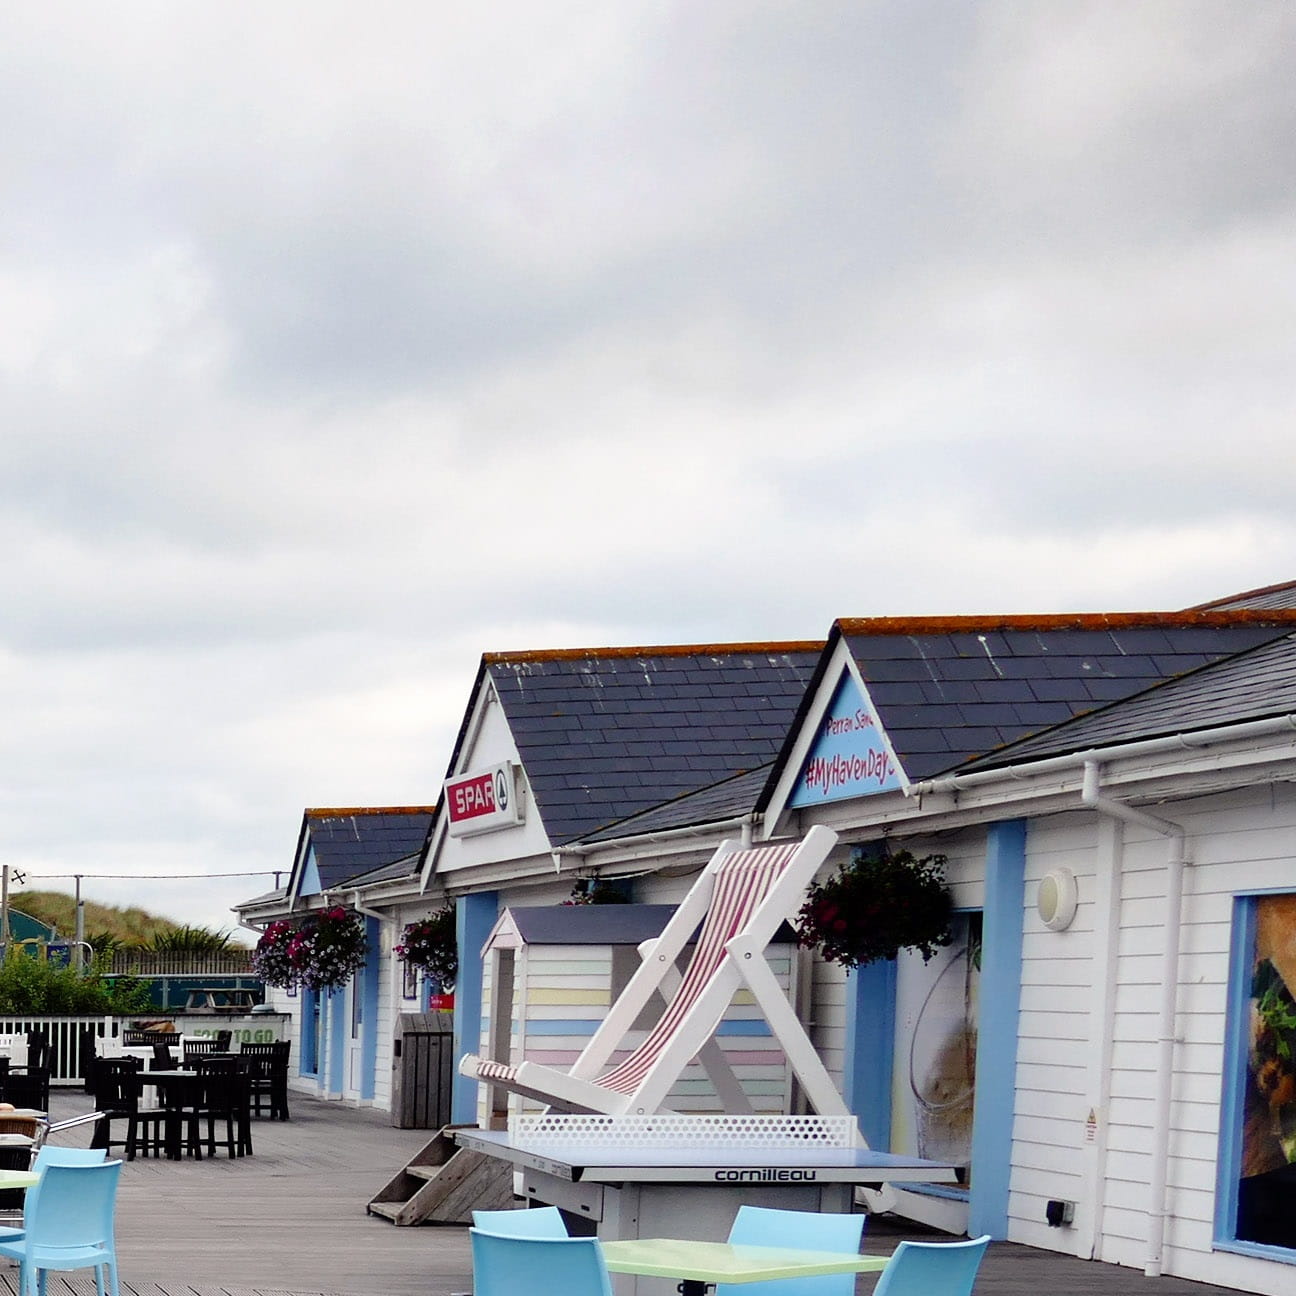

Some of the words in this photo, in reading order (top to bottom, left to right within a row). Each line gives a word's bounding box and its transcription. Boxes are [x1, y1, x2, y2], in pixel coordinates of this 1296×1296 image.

[456, 781, 495, 814] SPAR
[234, 1029, 251, 1043] TO
[255, 1029, 273, 1043] GO
[715, 1169, 816, 1180] cornilleau
